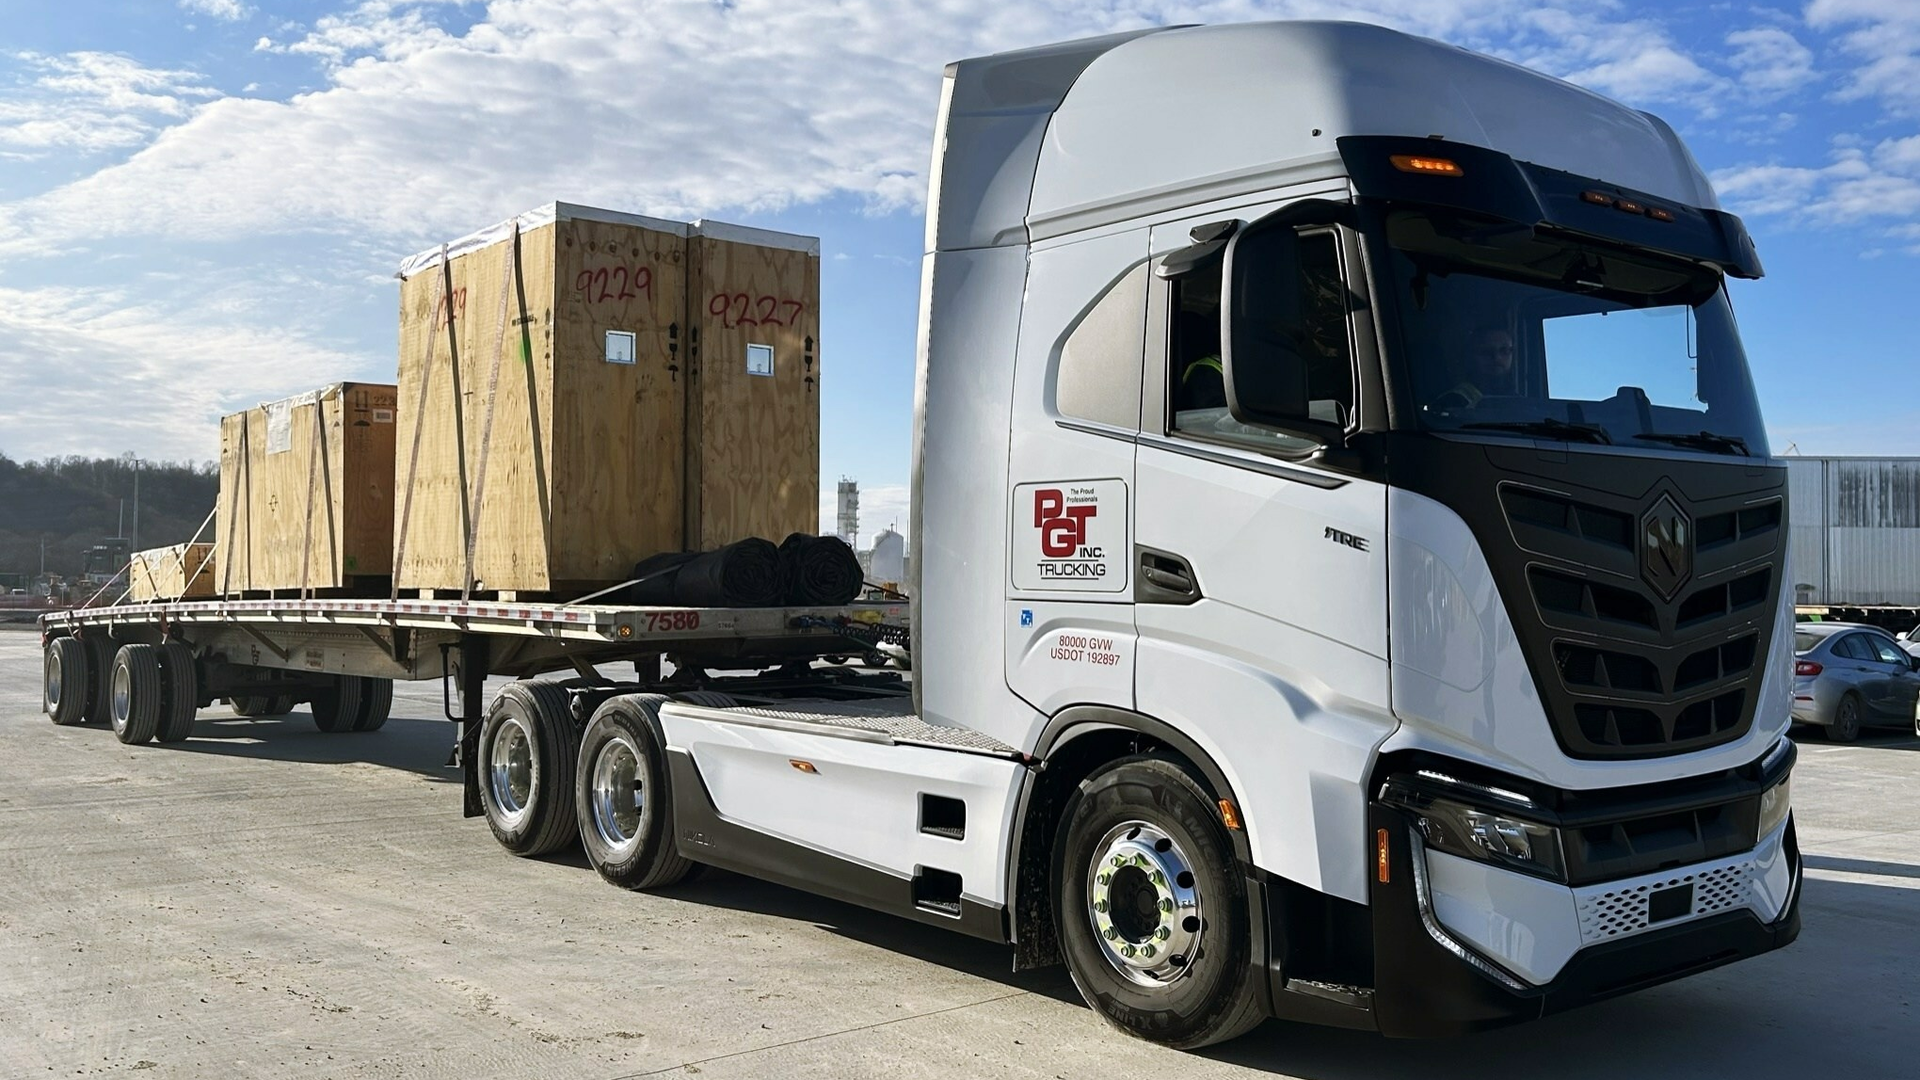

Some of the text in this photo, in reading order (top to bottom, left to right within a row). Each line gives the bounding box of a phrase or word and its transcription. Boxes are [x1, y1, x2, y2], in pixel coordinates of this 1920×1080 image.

[575, 266, 652, 304] 9229
[709, 292, 803, 329] 9227
[1080, 487, 1095, 495] Proud
[1034, 489, 1105, 558] PGT INC.
[1037, 563, 1106, 576] TRUCKING
[645, 611, 700, 632] 7580
[1059, 635, 1113, 651] 80000 GVW
[1050, 648, 1121, 666] USDOT 192897
[1106, 1004, 1136, 1027] LINE
